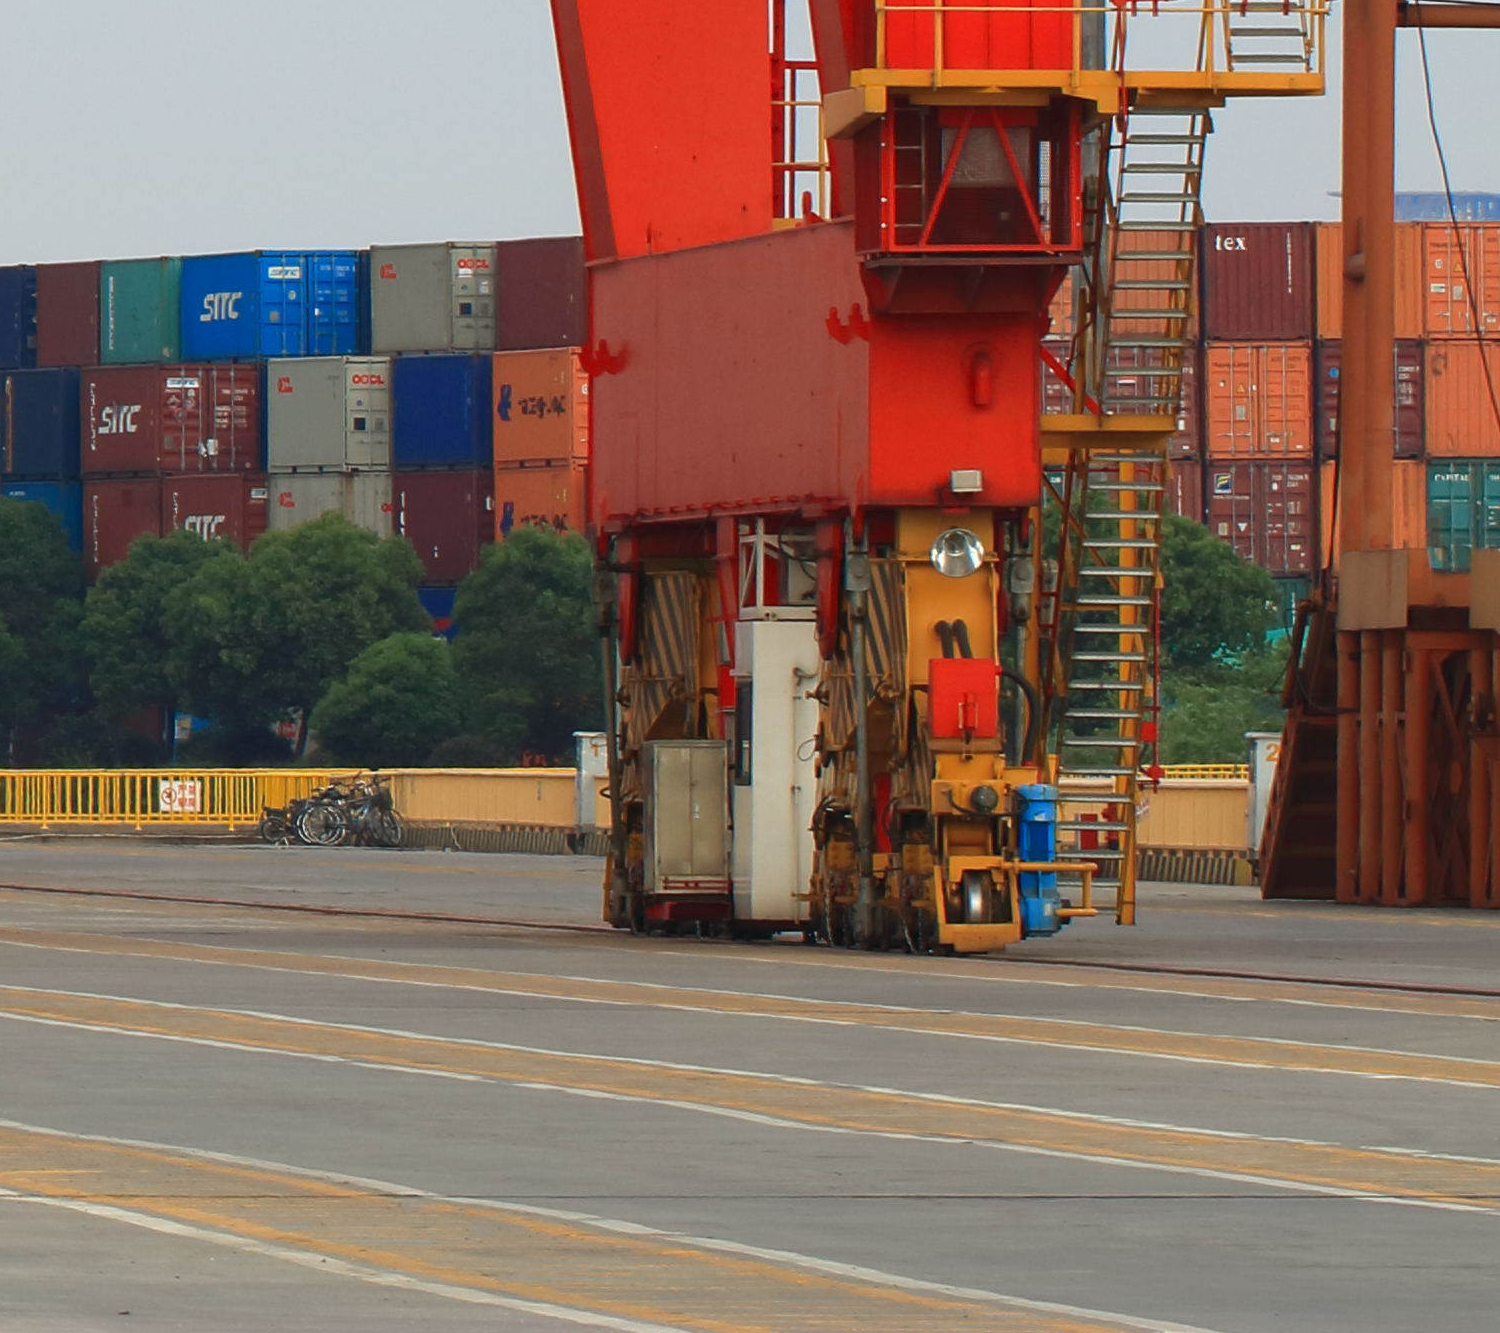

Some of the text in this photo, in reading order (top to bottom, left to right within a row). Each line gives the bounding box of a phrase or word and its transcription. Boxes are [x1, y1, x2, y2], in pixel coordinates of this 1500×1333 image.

[1215, 235, 1246, 251] tex
[200, 291, 243, 322] SITC
[98, 404, 142, 434] SITC
